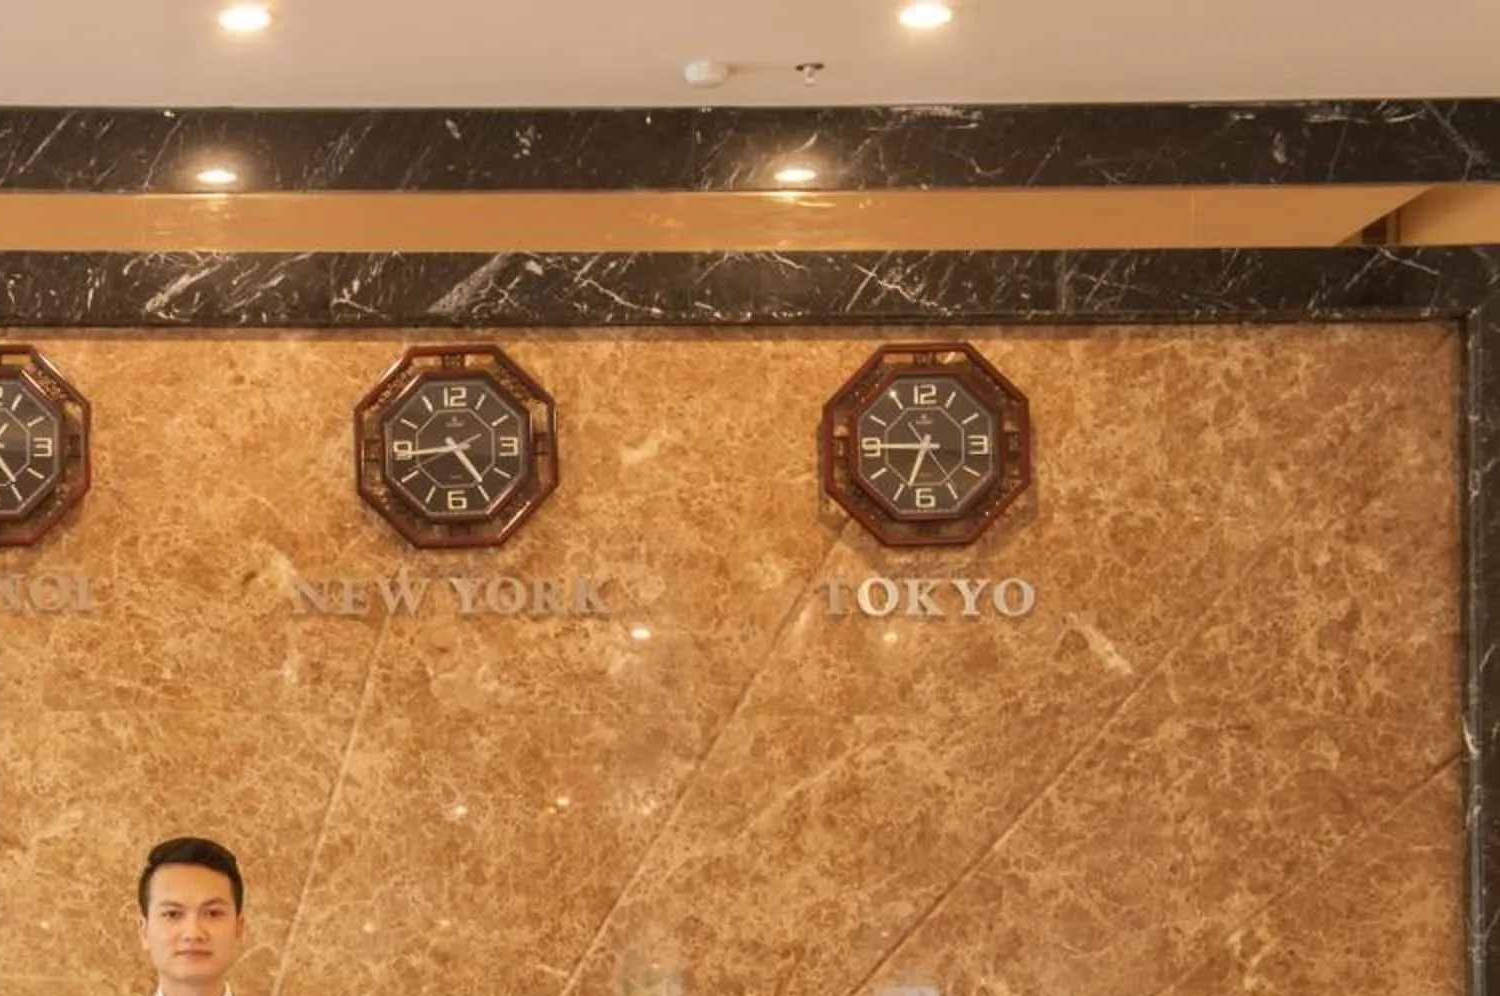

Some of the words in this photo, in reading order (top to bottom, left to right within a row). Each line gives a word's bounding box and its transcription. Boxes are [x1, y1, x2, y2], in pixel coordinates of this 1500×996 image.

[443, 386, 468, 408] 12
[913, 384, 937, 405] 12
[32, 437, 54, 457] 3
[499, 437, 519, 457] 3
[861, 437, 881, 458] 9
[967, 435, 989, 455] 3
[447, 489, 468, 510] 6
[915, 487, 936, 508] 6
[290, 574, 431, 616] NEW
[449, 576, 612, 616] YORK
[819, 576, 1036, 617] TOKYO
